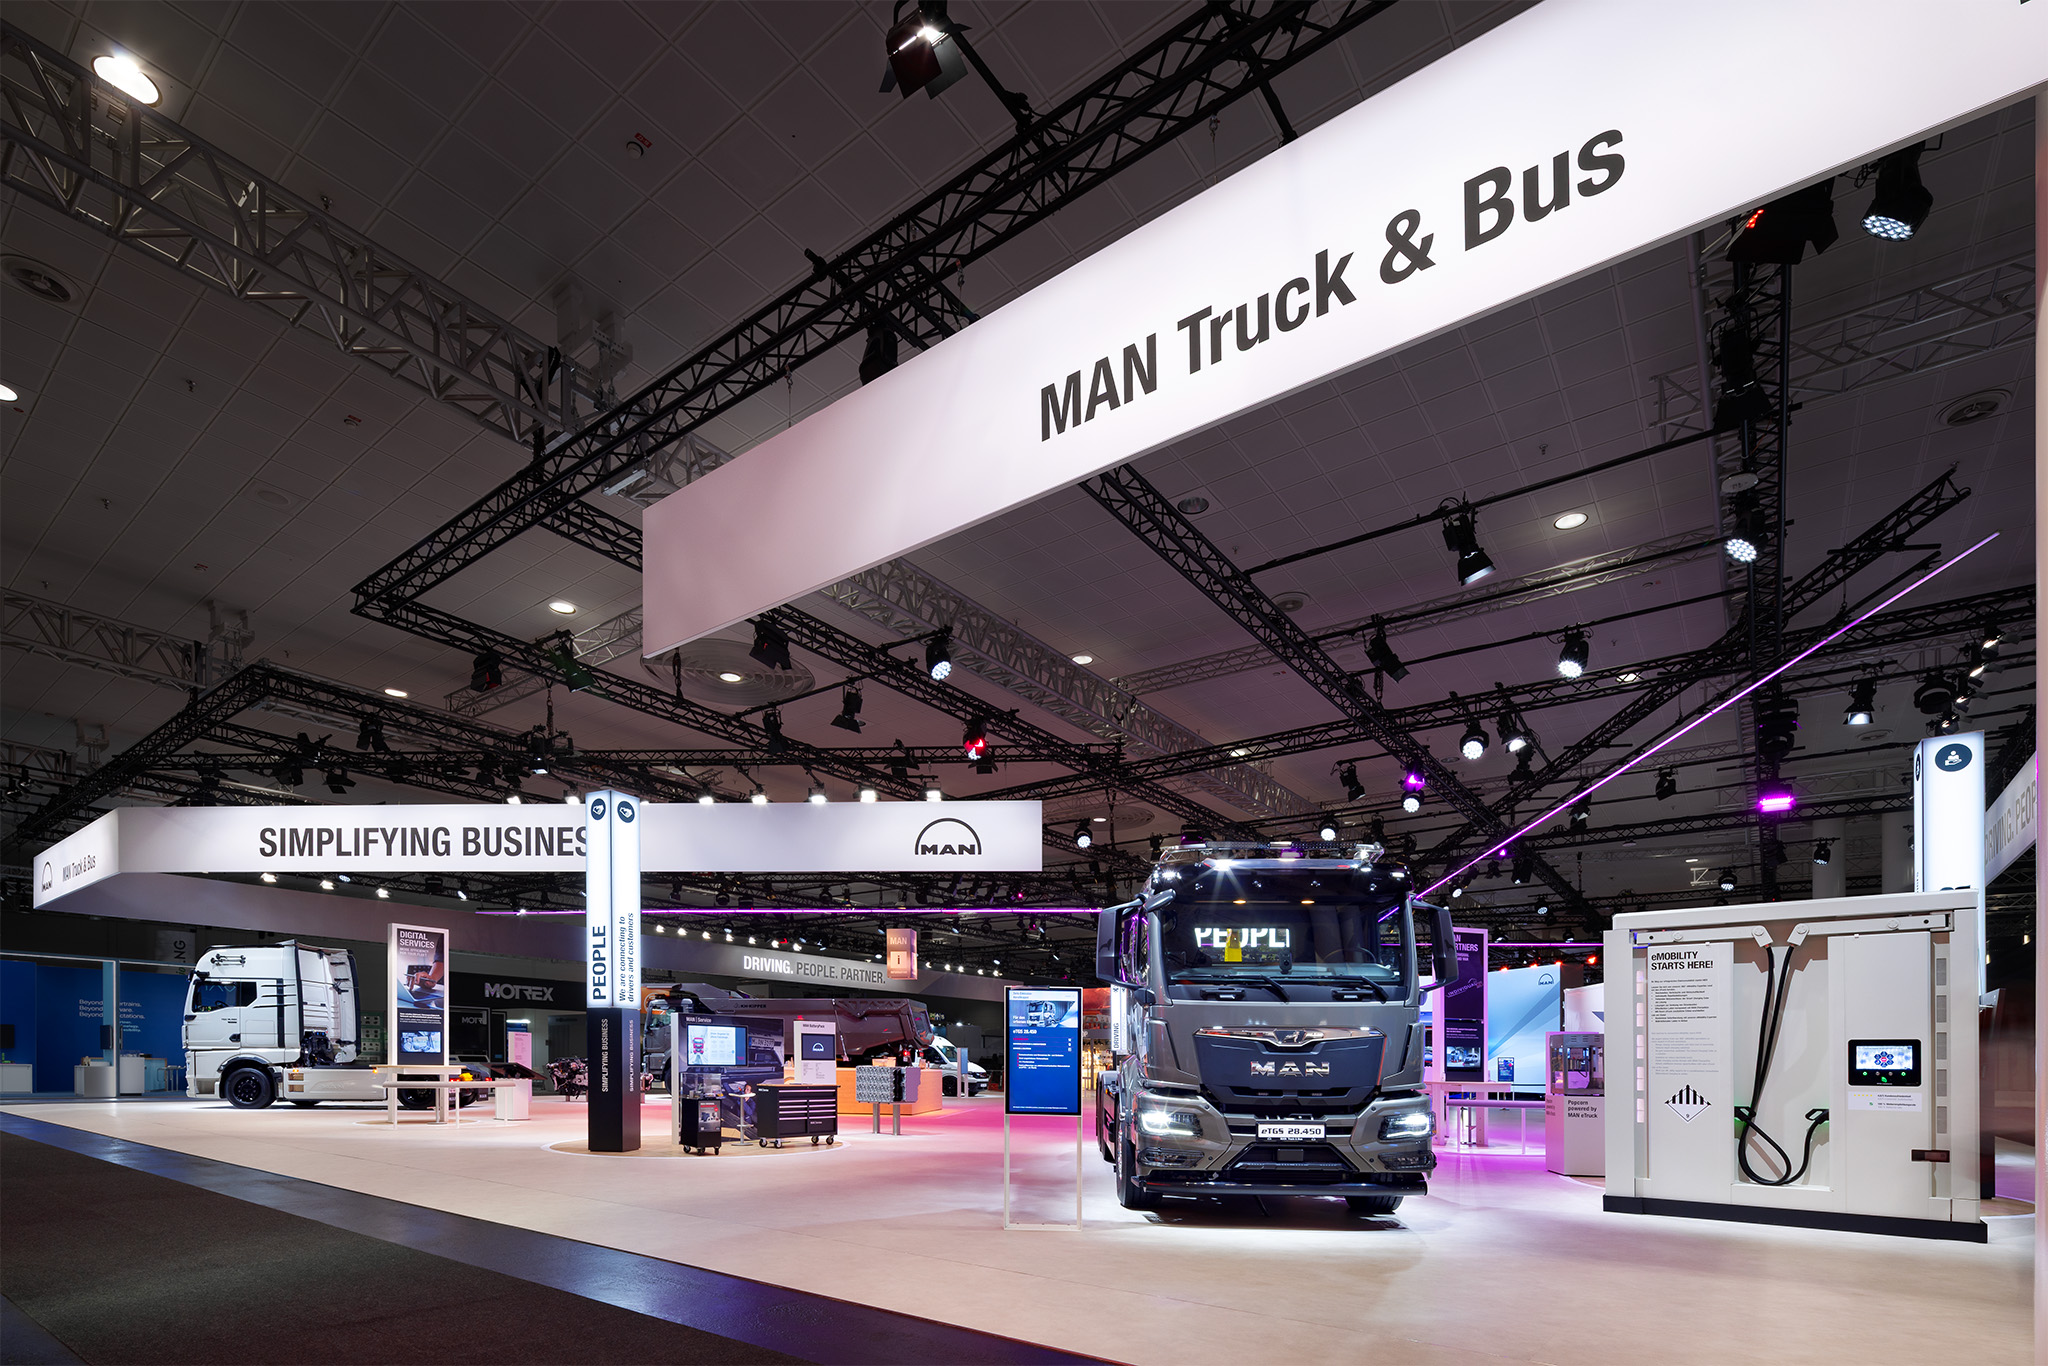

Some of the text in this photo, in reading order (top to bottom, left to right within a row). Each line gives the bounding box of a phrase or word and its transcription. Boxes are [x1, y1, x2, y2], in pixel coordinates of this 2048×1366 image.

[1041, 128, 1626, 443] MAN Truck & Bus
[259, 827, 451, 857] SIMPLIFYING
[920, 844, 976, 855] MAN
[63, 865, 71, 882] MAN
[88, 854, 96, 870] Bus
[619, 916, 625, 925] to
[400, 930, 428, 941] DIGITAL
[890, 937, 907, 945] MAN
[400, 939, 435, 949] SERVICES
[619, 927, 627, 971] connecting
[592, 925, 606, 1000] PEOPLE
[1651, 951, 1698, 961] eMOBILITY
[743, 955, 886, 984] DRIVING. PEOPLE. PARTNER.
[1651, 960, 1714, 970] STARTS HERE!
[484, 982, 554, 1001] MOTREX
[619, 989, 626, 1002] We
[1250, 1061, 1331, 1077] MAN
[1261, 1127, 1322, 1135] eTGS 28.450
